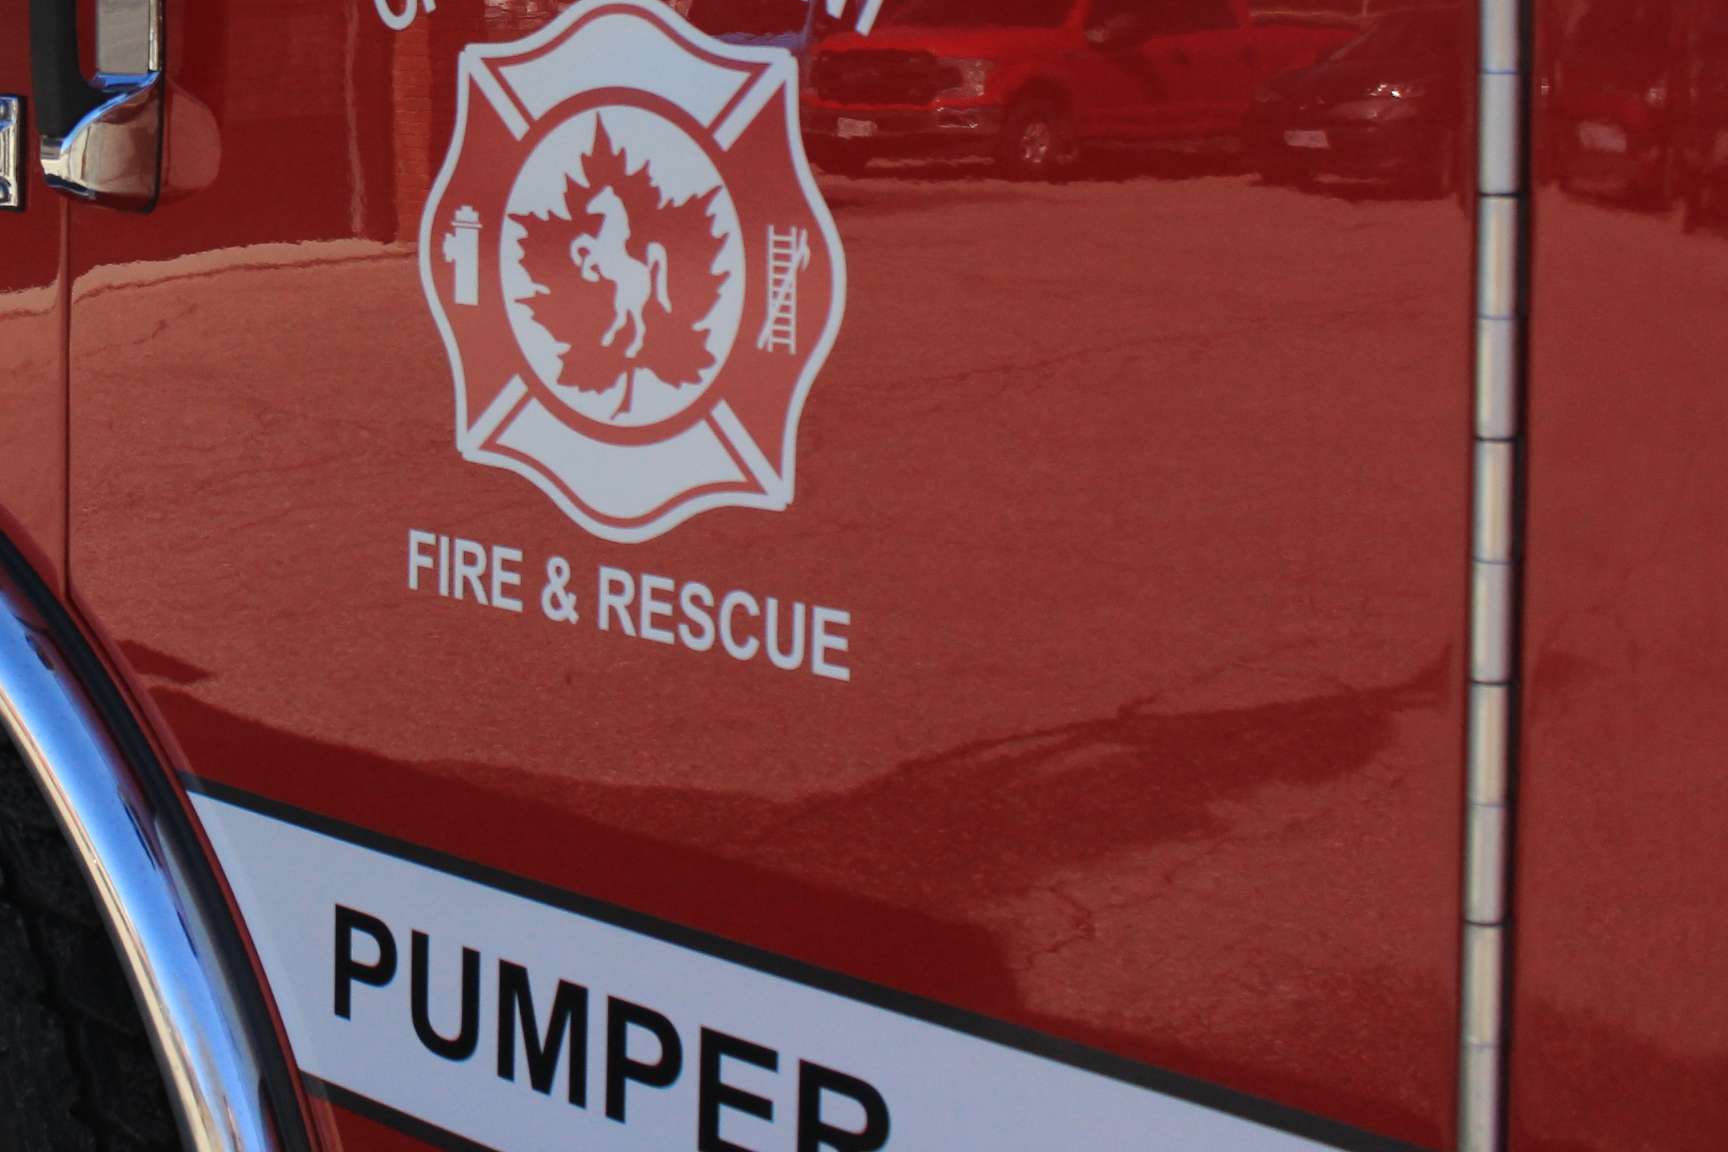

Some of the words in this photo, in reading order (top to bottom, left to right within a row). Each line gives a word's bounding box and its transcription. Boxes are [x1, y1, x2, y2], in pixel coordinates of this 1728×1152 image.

[408, 529, 524, 612] FIRE
[541, 556, 580, 625] &
[598, 566, 851, 682] RESCUE
[333, 903, 892, 1152] PUMPER
